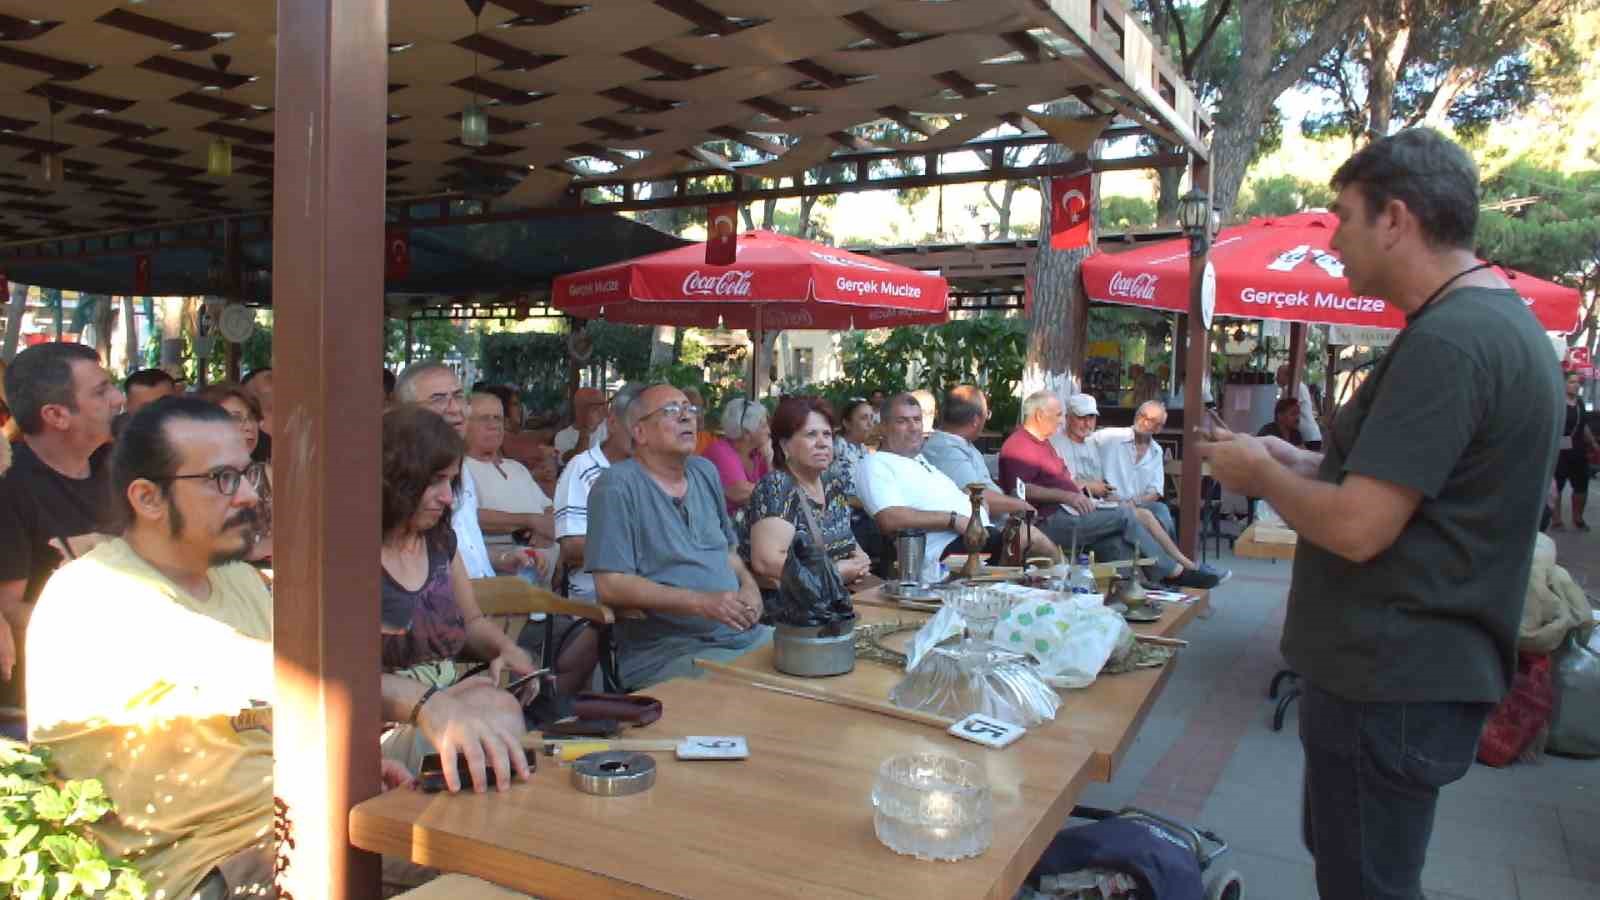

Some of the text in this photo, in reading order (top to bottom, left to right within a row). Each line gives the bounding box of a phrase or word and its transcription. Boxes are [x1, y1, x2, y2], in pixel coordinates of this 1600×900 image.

[836, 277, 922, 298] Gerçek Mucize
[1240, 287, 1385, 312] Gerçek Mucize
